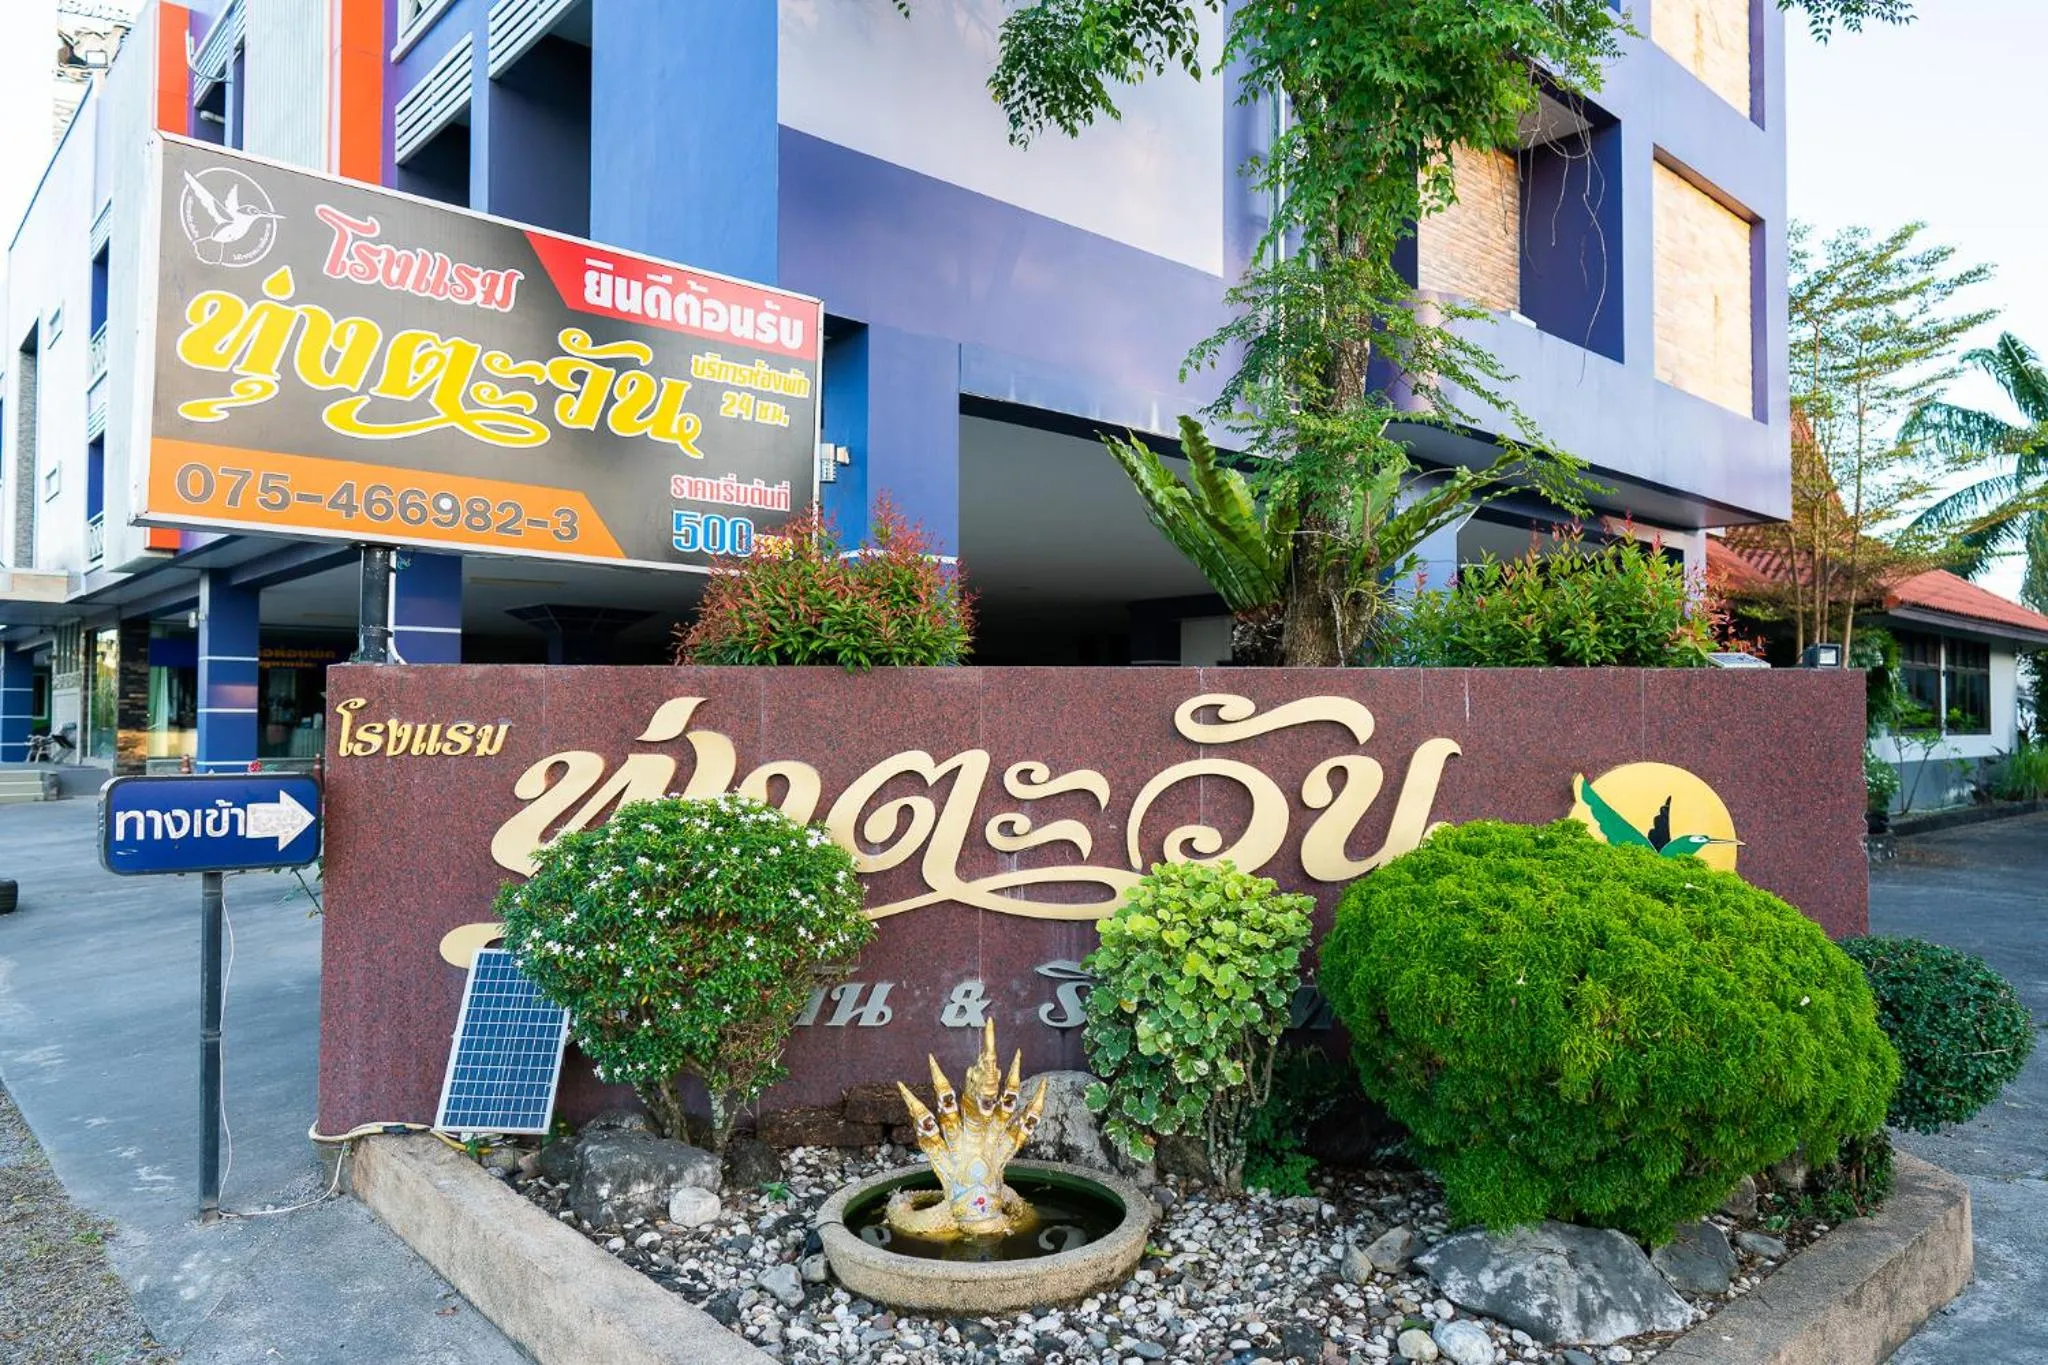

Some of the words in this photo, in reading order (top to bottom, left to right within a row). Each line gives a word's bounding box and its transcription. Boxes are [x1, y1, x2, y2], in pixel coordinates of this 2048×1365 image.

[315, 204, 526, 313] โรงแรม
[584, 258, 803, 350] ยินดีต้อนรับ
[177, 265, 704, 459] ทุ่งตะวัน
[691, 352, 811, 398] บริการห้องพัก
[720, 391, 755, 420] 24
[175, 463, 581, 543] 075-466982-3
[671, 473, 791, 512] ราคาเริ่มต้นที่
[672, 510, 754, 557] 500
[333, 697, 512, 757] โรงแรม
[115, 799, 246, 841] ทางเข้า
[439, 693, 1463, 968] ท่งตะวัน
[940, 980, 992, 1028] &
